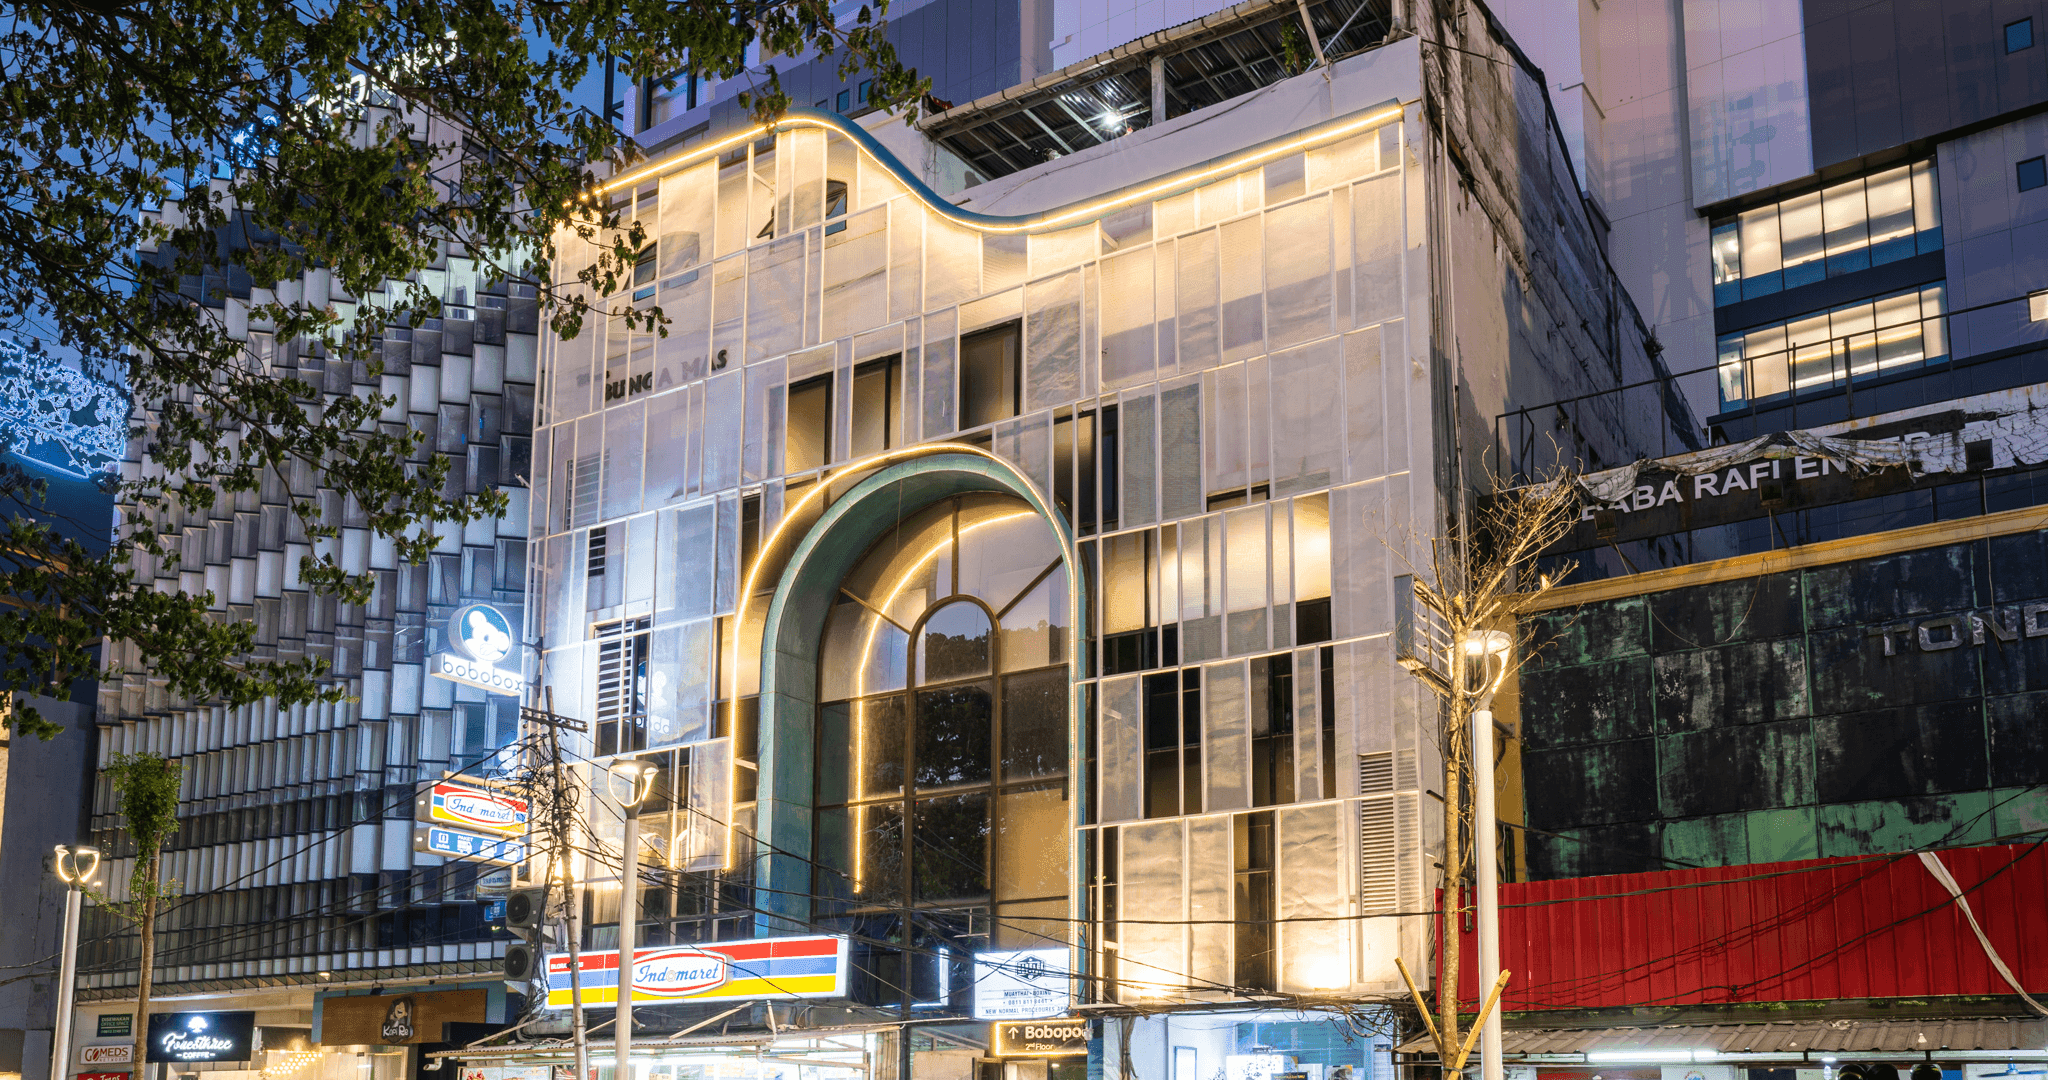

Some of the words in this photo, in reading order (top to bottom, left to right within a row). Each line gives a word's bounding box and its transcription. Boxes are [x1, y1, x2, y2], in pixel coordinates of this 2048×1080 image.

[1694, 459, 1780, 500] RAFI
[443, 654, 523, 692] bobobox
[449, 798, 512, 821] Indmaret
[635, 963, 719, 983] Indomaret
